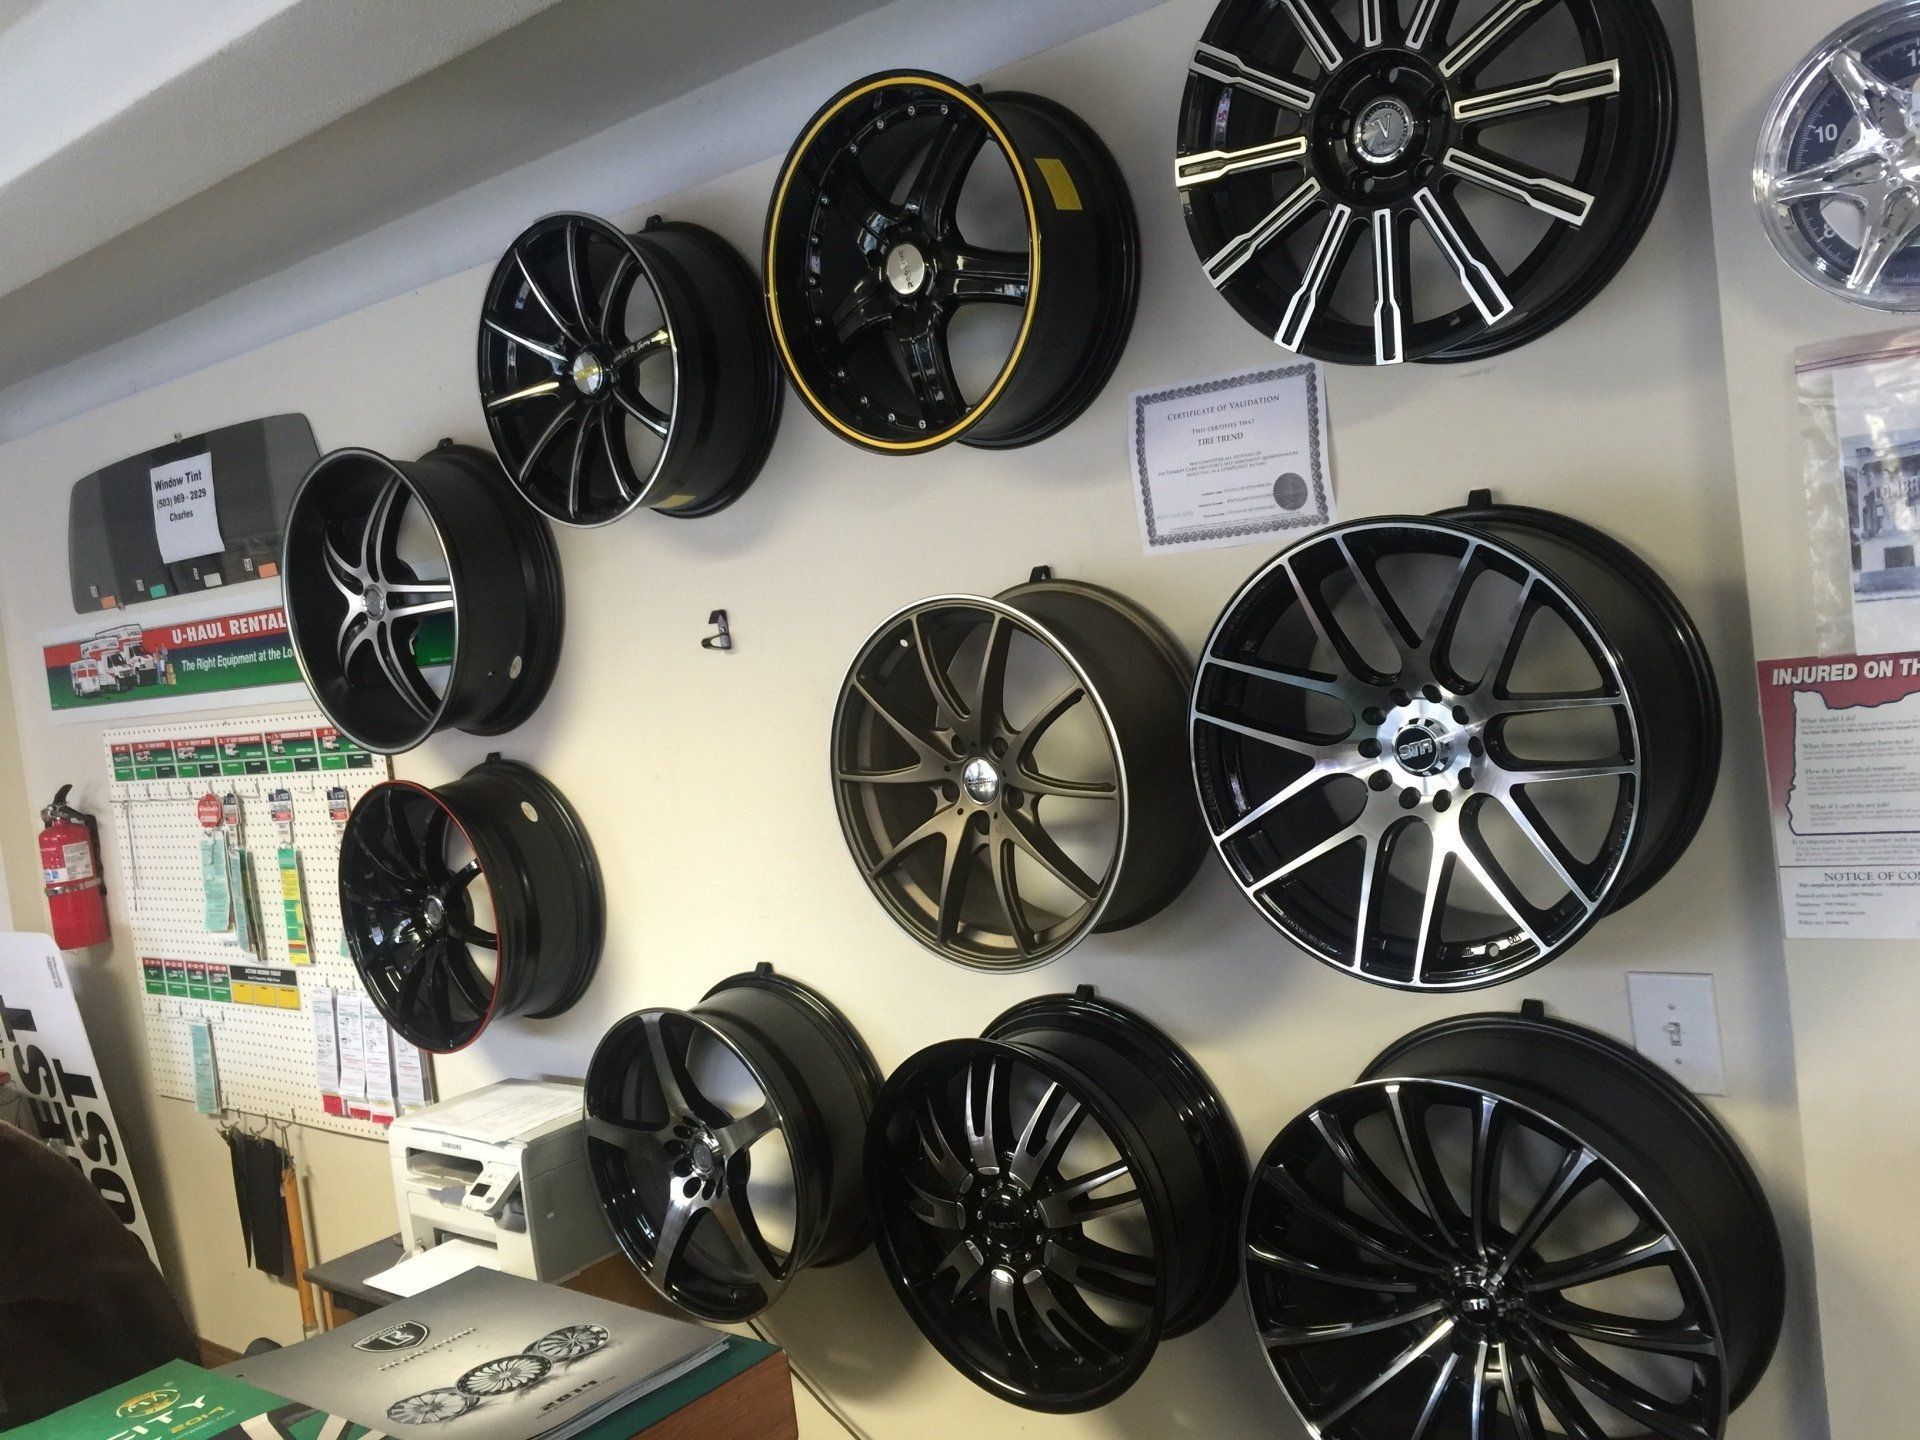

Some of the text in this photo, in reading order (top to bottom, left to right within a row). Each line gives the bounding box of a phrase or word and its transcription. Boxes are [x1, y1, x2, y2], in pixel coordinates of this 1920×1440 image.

[1907, 49, 1920, 66] 1
[1815, 123, 1838, 142] 10
[1167, 395, 1280, 421] CERTIFICATE OF VALIDATION
[1197, 432, 1244, 447] TIRE TREND
[154, 470, 202, 492] Window Tint
[157, 496, 173, 511] (503)
[189, 488, 207, 501] 2829
[169, 510, 194, 522] Charles
[171, 622, 226, 644] U-HAUL
[181, 646, 294, 672] The Right Equipment at the Lo
[1772, 663, 1858, 685] INJURED
[1863, 660, 1894, 678] ON
[1399, 738, 1433, 760] STR
[1824, 871, 1920, 882] NOTICE OF CO
[442, 1141, 462, 1150] SAMSUNG
